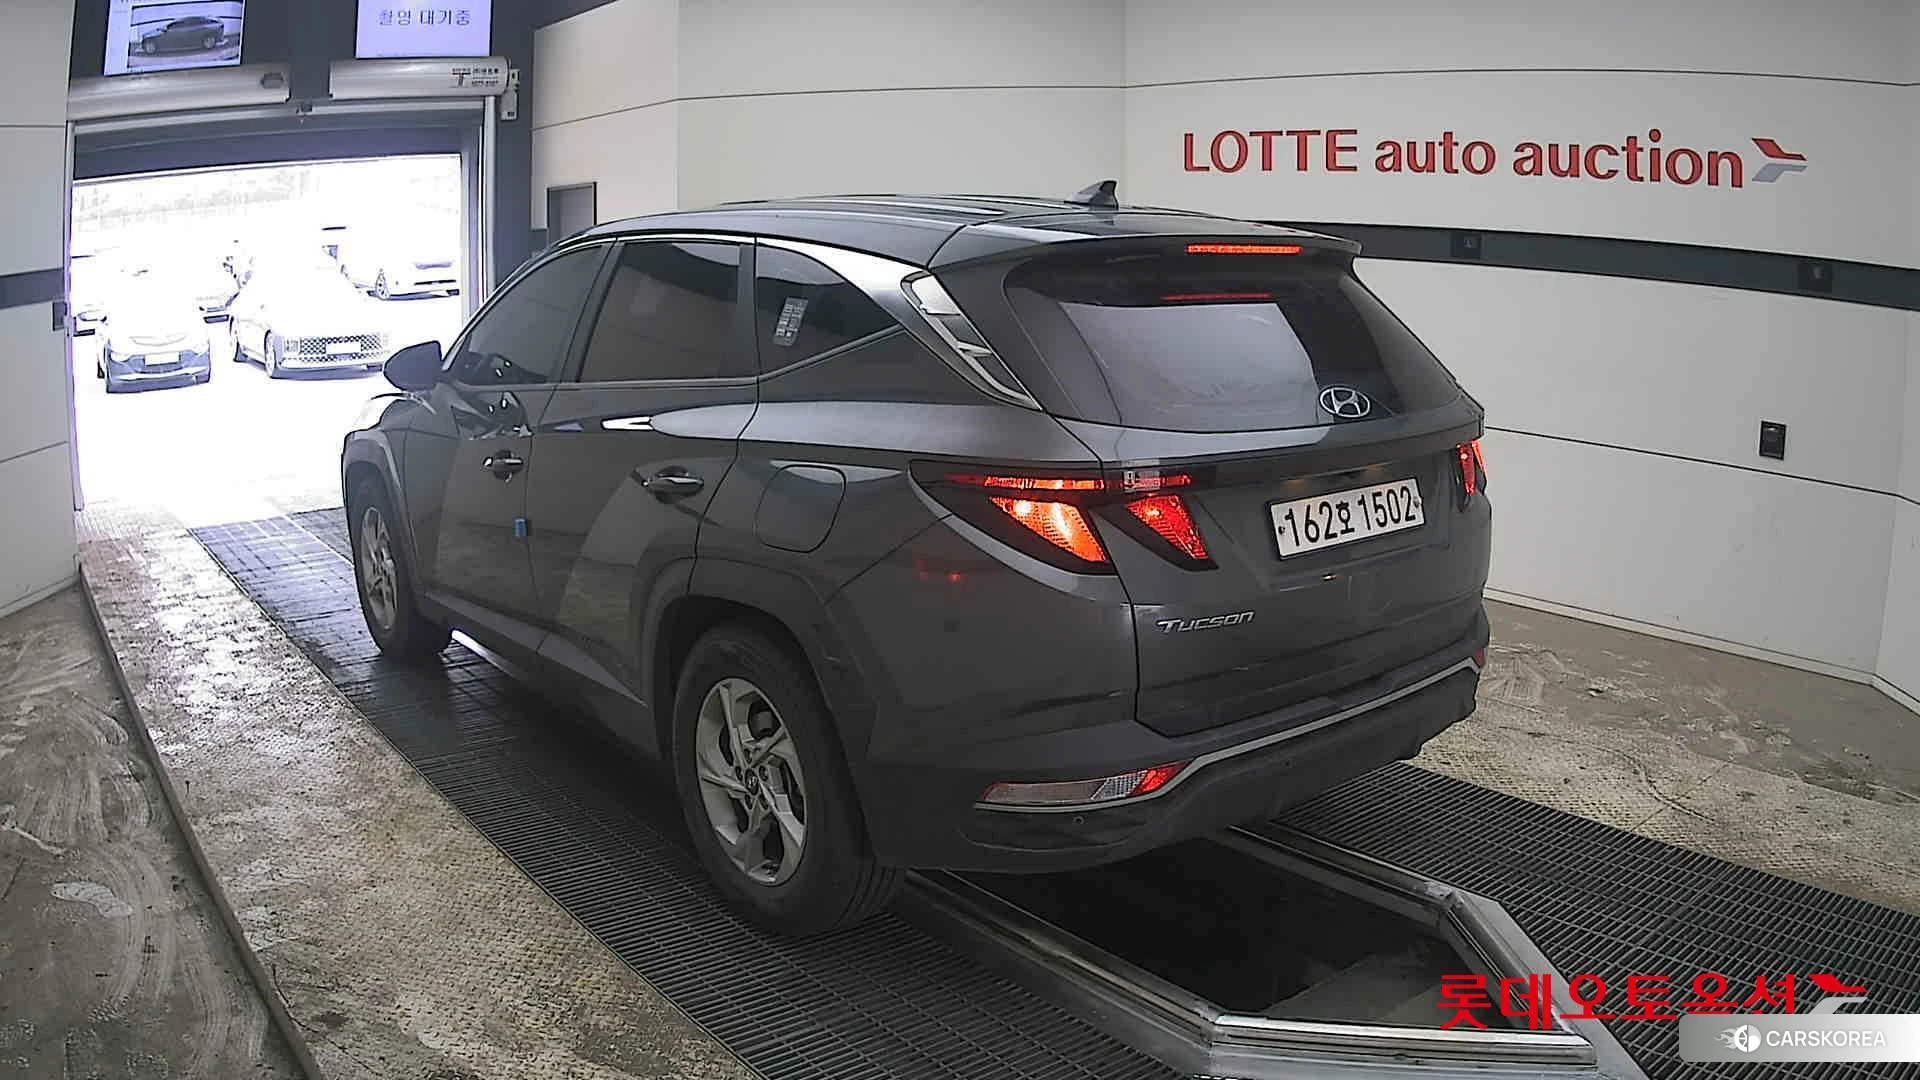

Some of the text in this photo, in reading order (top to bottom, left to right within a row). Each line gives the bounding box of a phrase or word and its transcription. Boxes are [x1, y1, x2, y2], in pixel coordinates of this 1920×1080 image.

[420, 9, 471, 26] 대기중
[1184, 128, 1743, 188] LOTTE auto auction
[1285, 486, 1416, 547] 162호 1502
